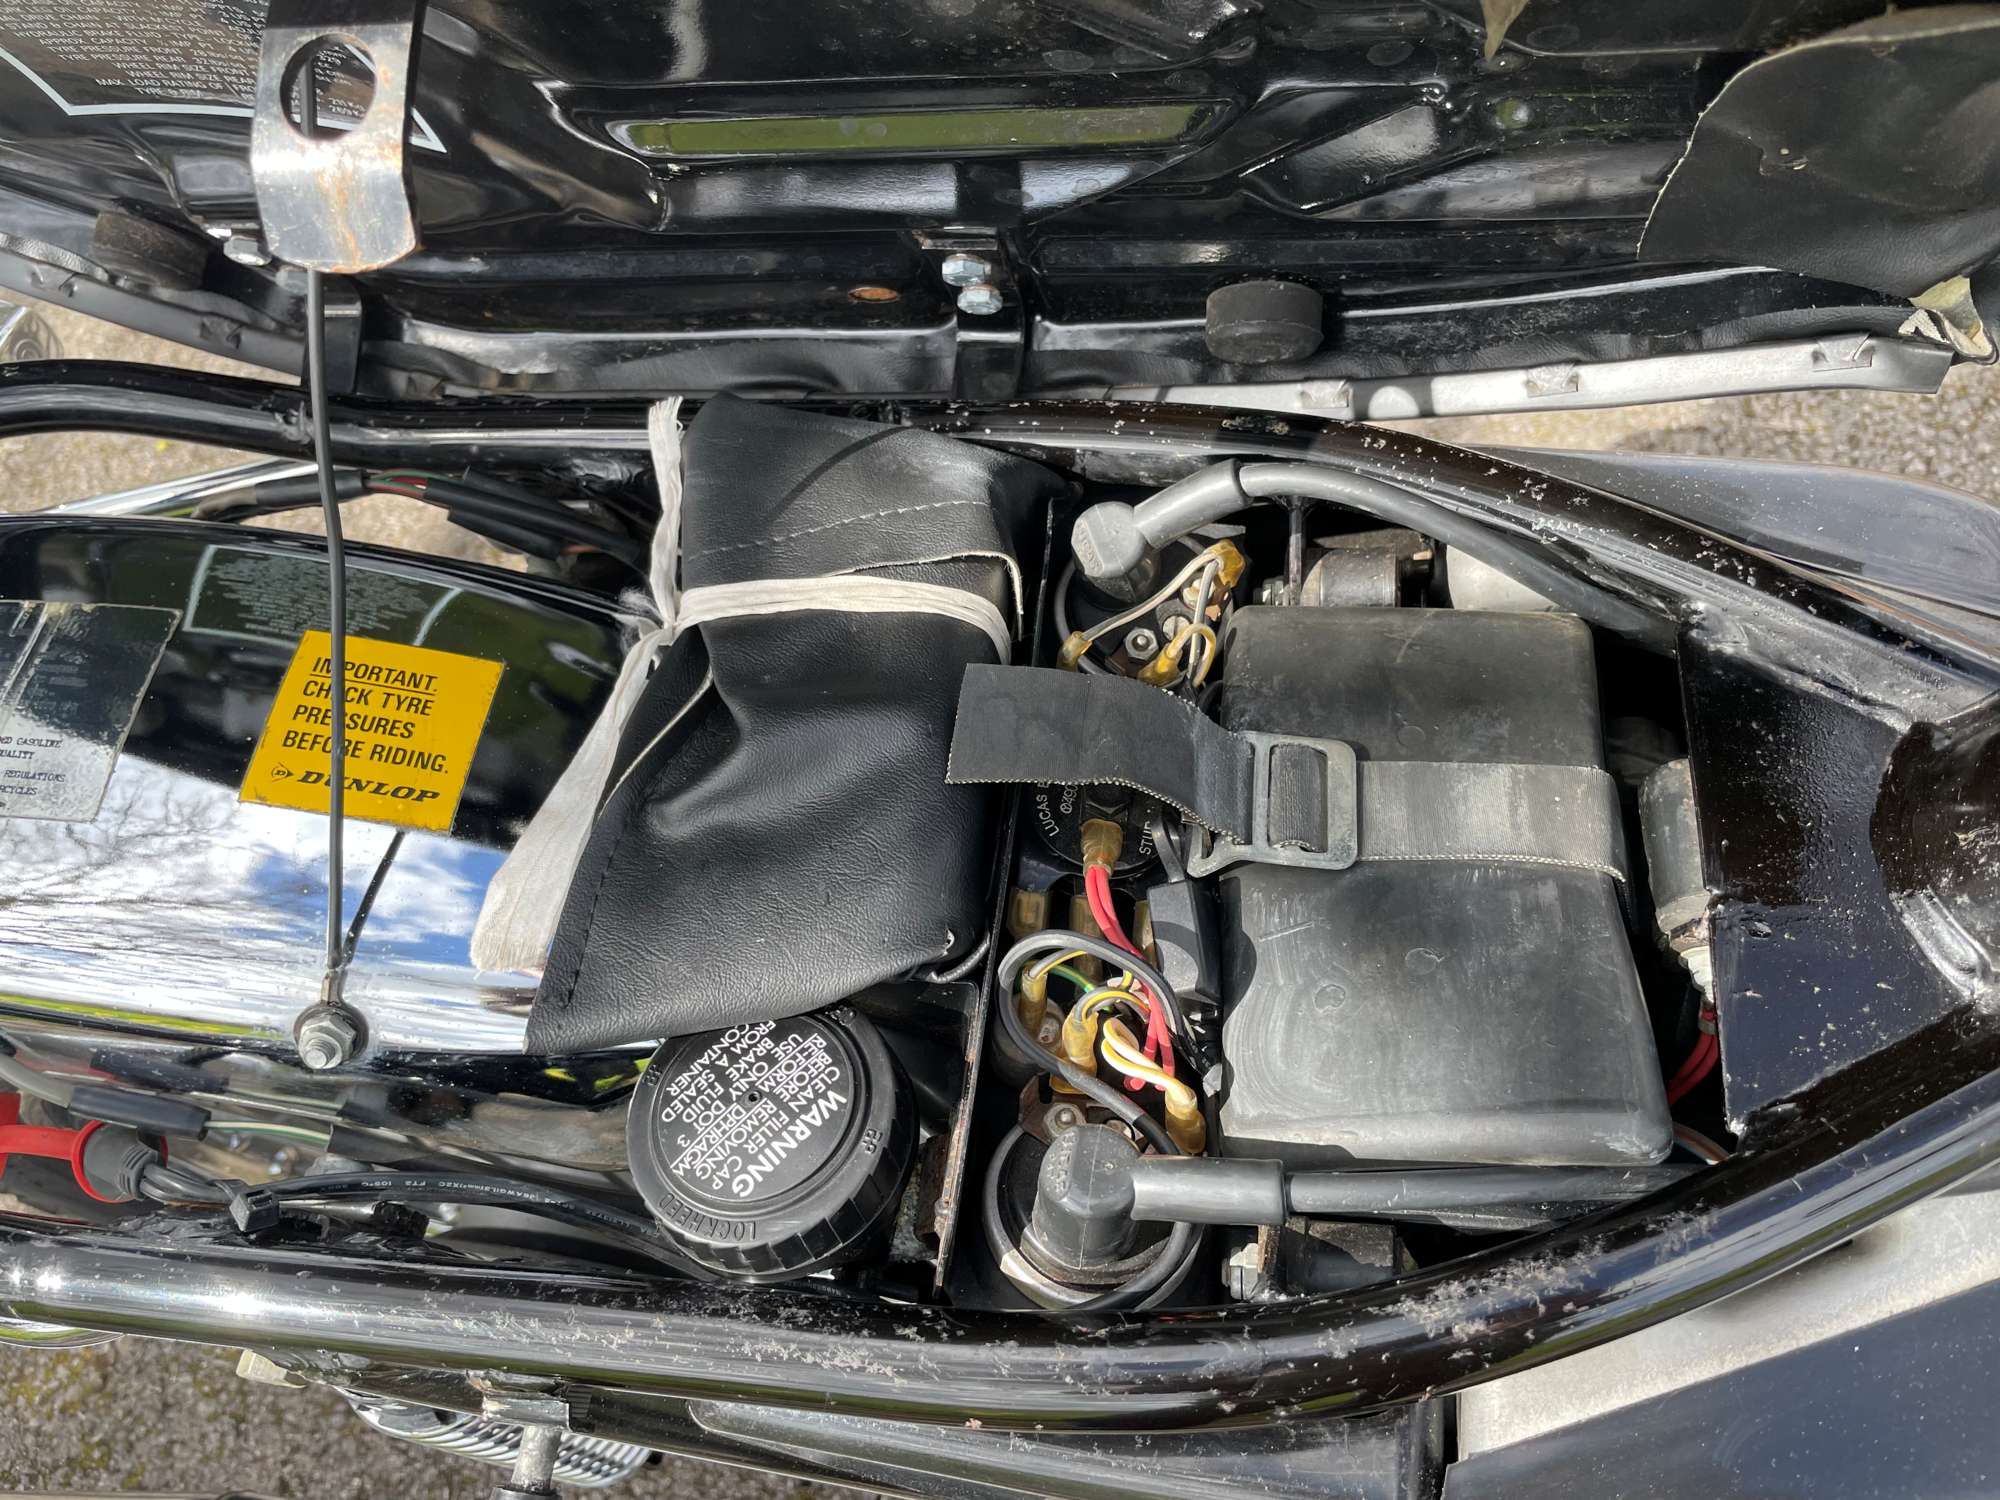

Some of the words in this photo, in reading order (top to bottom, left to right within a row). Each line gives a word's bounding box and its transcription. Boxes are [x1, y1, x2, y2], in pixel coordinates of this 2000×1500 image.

[303, 680, 373, 706] CHCK
[381, 692, 435, 716] TYRE
[292, 704, 416, 739] PRESURES
[17, 737, 63, 748] GASOLINE
[369, 743, 449, 774] RIDING.
[4, 769, 66, 782] REGULATIONS
[297, 770, 441, 802] DNLOP
[1036, 795, 1059, 837] LUCAS
[729, 1020, 777, 1055] FROM
[770, 1033, 803, 1061] USE
[665, 1023, 750, 1097] CONTAINER
[714, 1053, 729, 1067] A
[725, 1037, 775, 1081] BRAKE
[759, 1034, 828, 1094] RE-FORM
[776, 1049, 833, 1102] BEFORE
[661, 1069, 716, 1124] SEALED
[729, 1061, 769, 1102] ONLY
[789, 1066, 841, 1113] CLEAN
[681, 1081, 725, 1124] FLUID
[693, 1099, 727, 1134] DOT
[672, 1103, 749, 1177] DPHRAGM
[677, 1134, 691, 1147] 3
[695, 1098, 778, 1181] REMOVING
[731, 1090, 847, 1197] WARNING
[747, 1108, 790, 1155] FILLER
[712, 1156, 743, 1190] CAP
[657, 1192, 757, 1241] LOCKHEED
